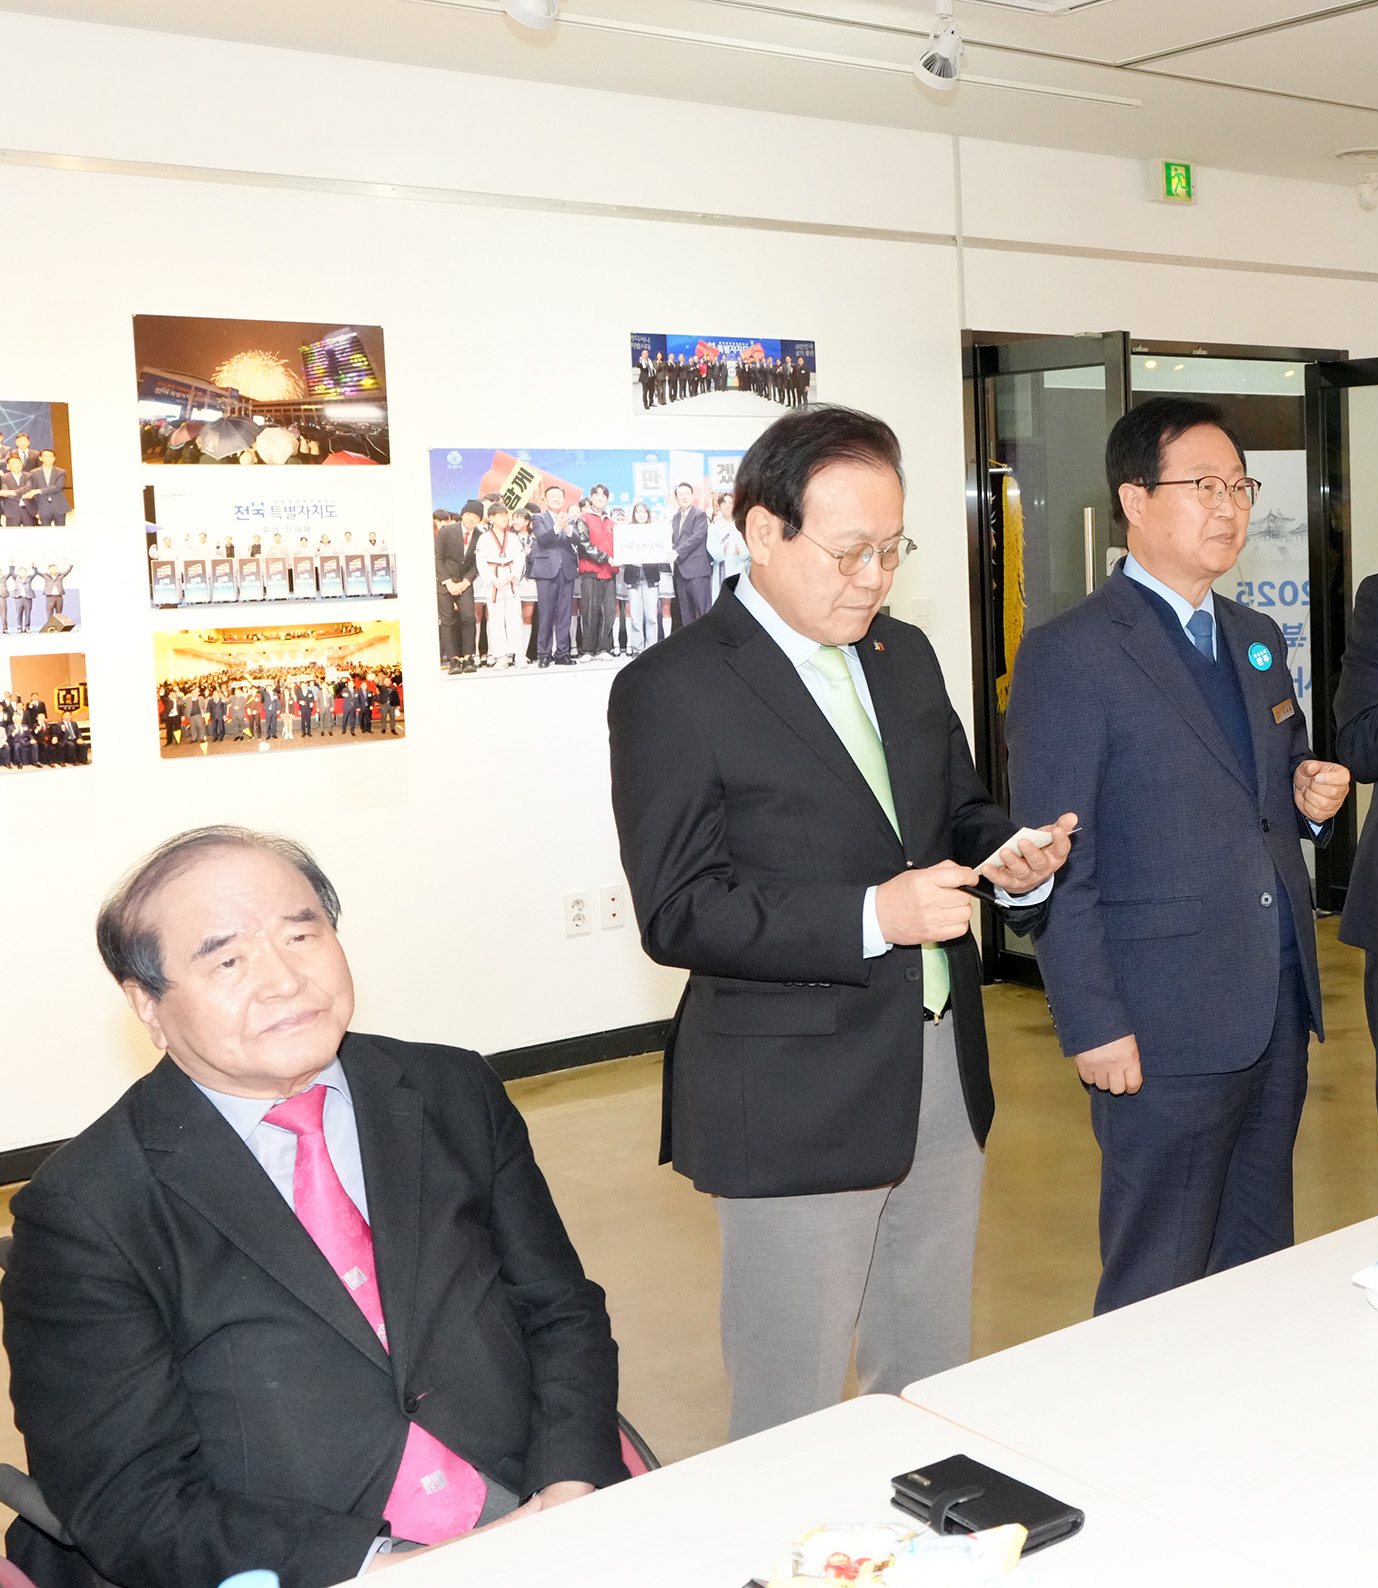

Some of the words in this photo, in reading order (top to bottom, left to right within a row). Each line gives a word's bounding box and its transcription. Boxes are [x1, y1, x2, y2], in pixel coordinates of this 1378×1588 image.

[642, 469, 661, 490] 만
[717, 463, 735, 484] 겠
[503, 466, 535, 511] 함께
[234, 502, 264, 520] 전북
[270, 504, 337, 520] 특별자치도
